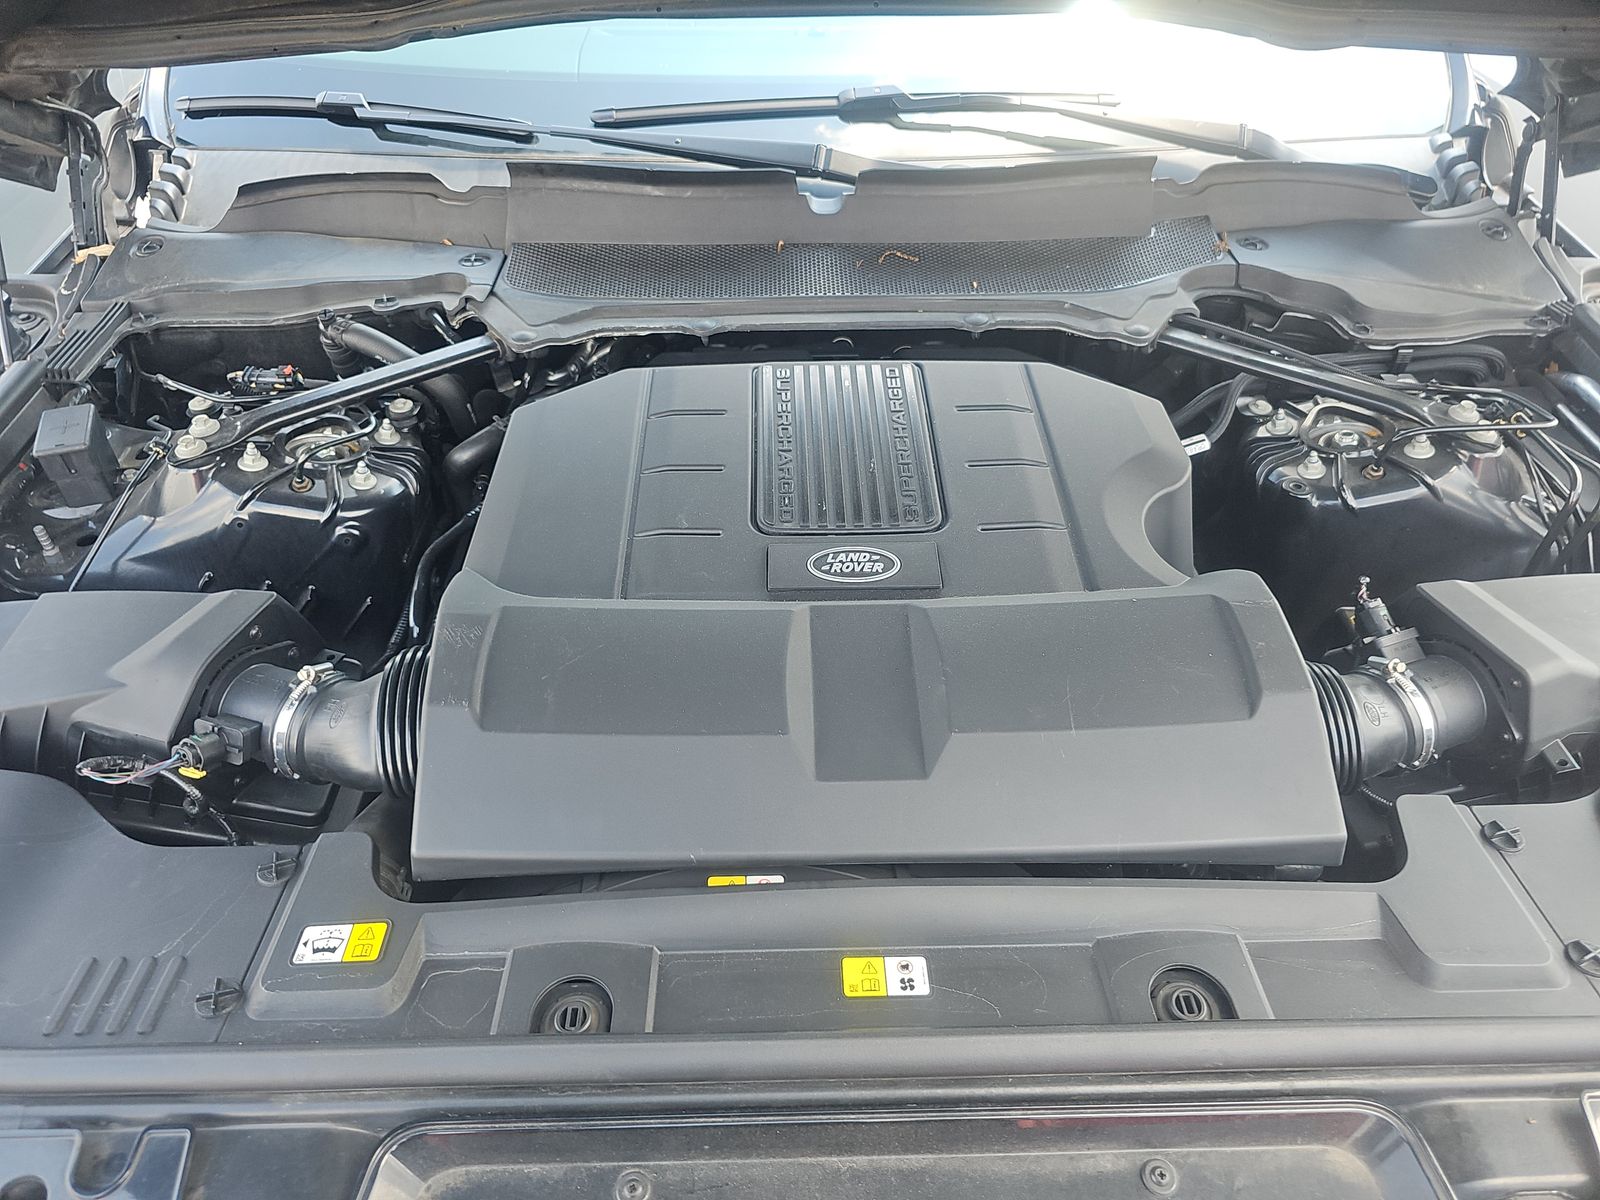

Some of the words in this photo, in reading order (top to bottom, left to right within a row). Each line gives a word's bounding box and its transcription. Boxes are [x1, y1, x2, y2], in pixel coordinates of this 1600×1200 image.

[776, 368, 795, 523] SUPERCHARGED
[886, 367, 919, 522] SUPERCHARGED
[826, 553, 871, 563] LAND
[832, 562, 885, 573] ROVER
